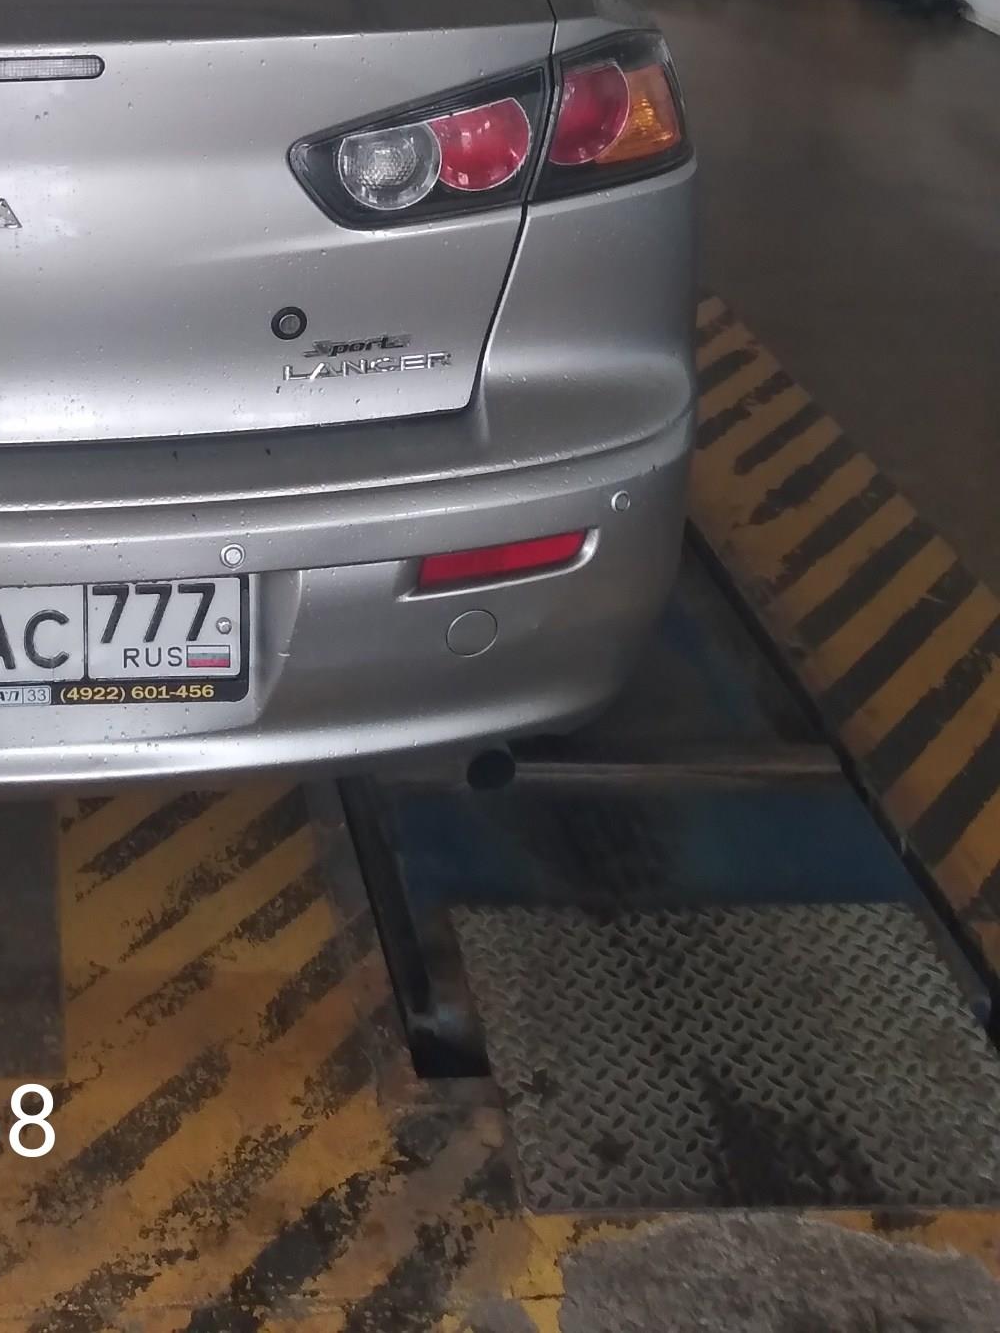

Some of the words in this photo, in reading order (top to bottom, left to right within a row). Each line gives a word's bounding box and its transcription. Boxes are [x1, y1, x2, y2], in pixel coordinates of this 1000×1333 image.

[282, 351, 451, 380] LANCER
[92, 583, 216, 643] 777
[123, 647, 182, 668] RUS
[27, 689, 47, 702] 33
[59, 685, 126, 702] (4922)
[131, 684, 215, 699] 601-456
